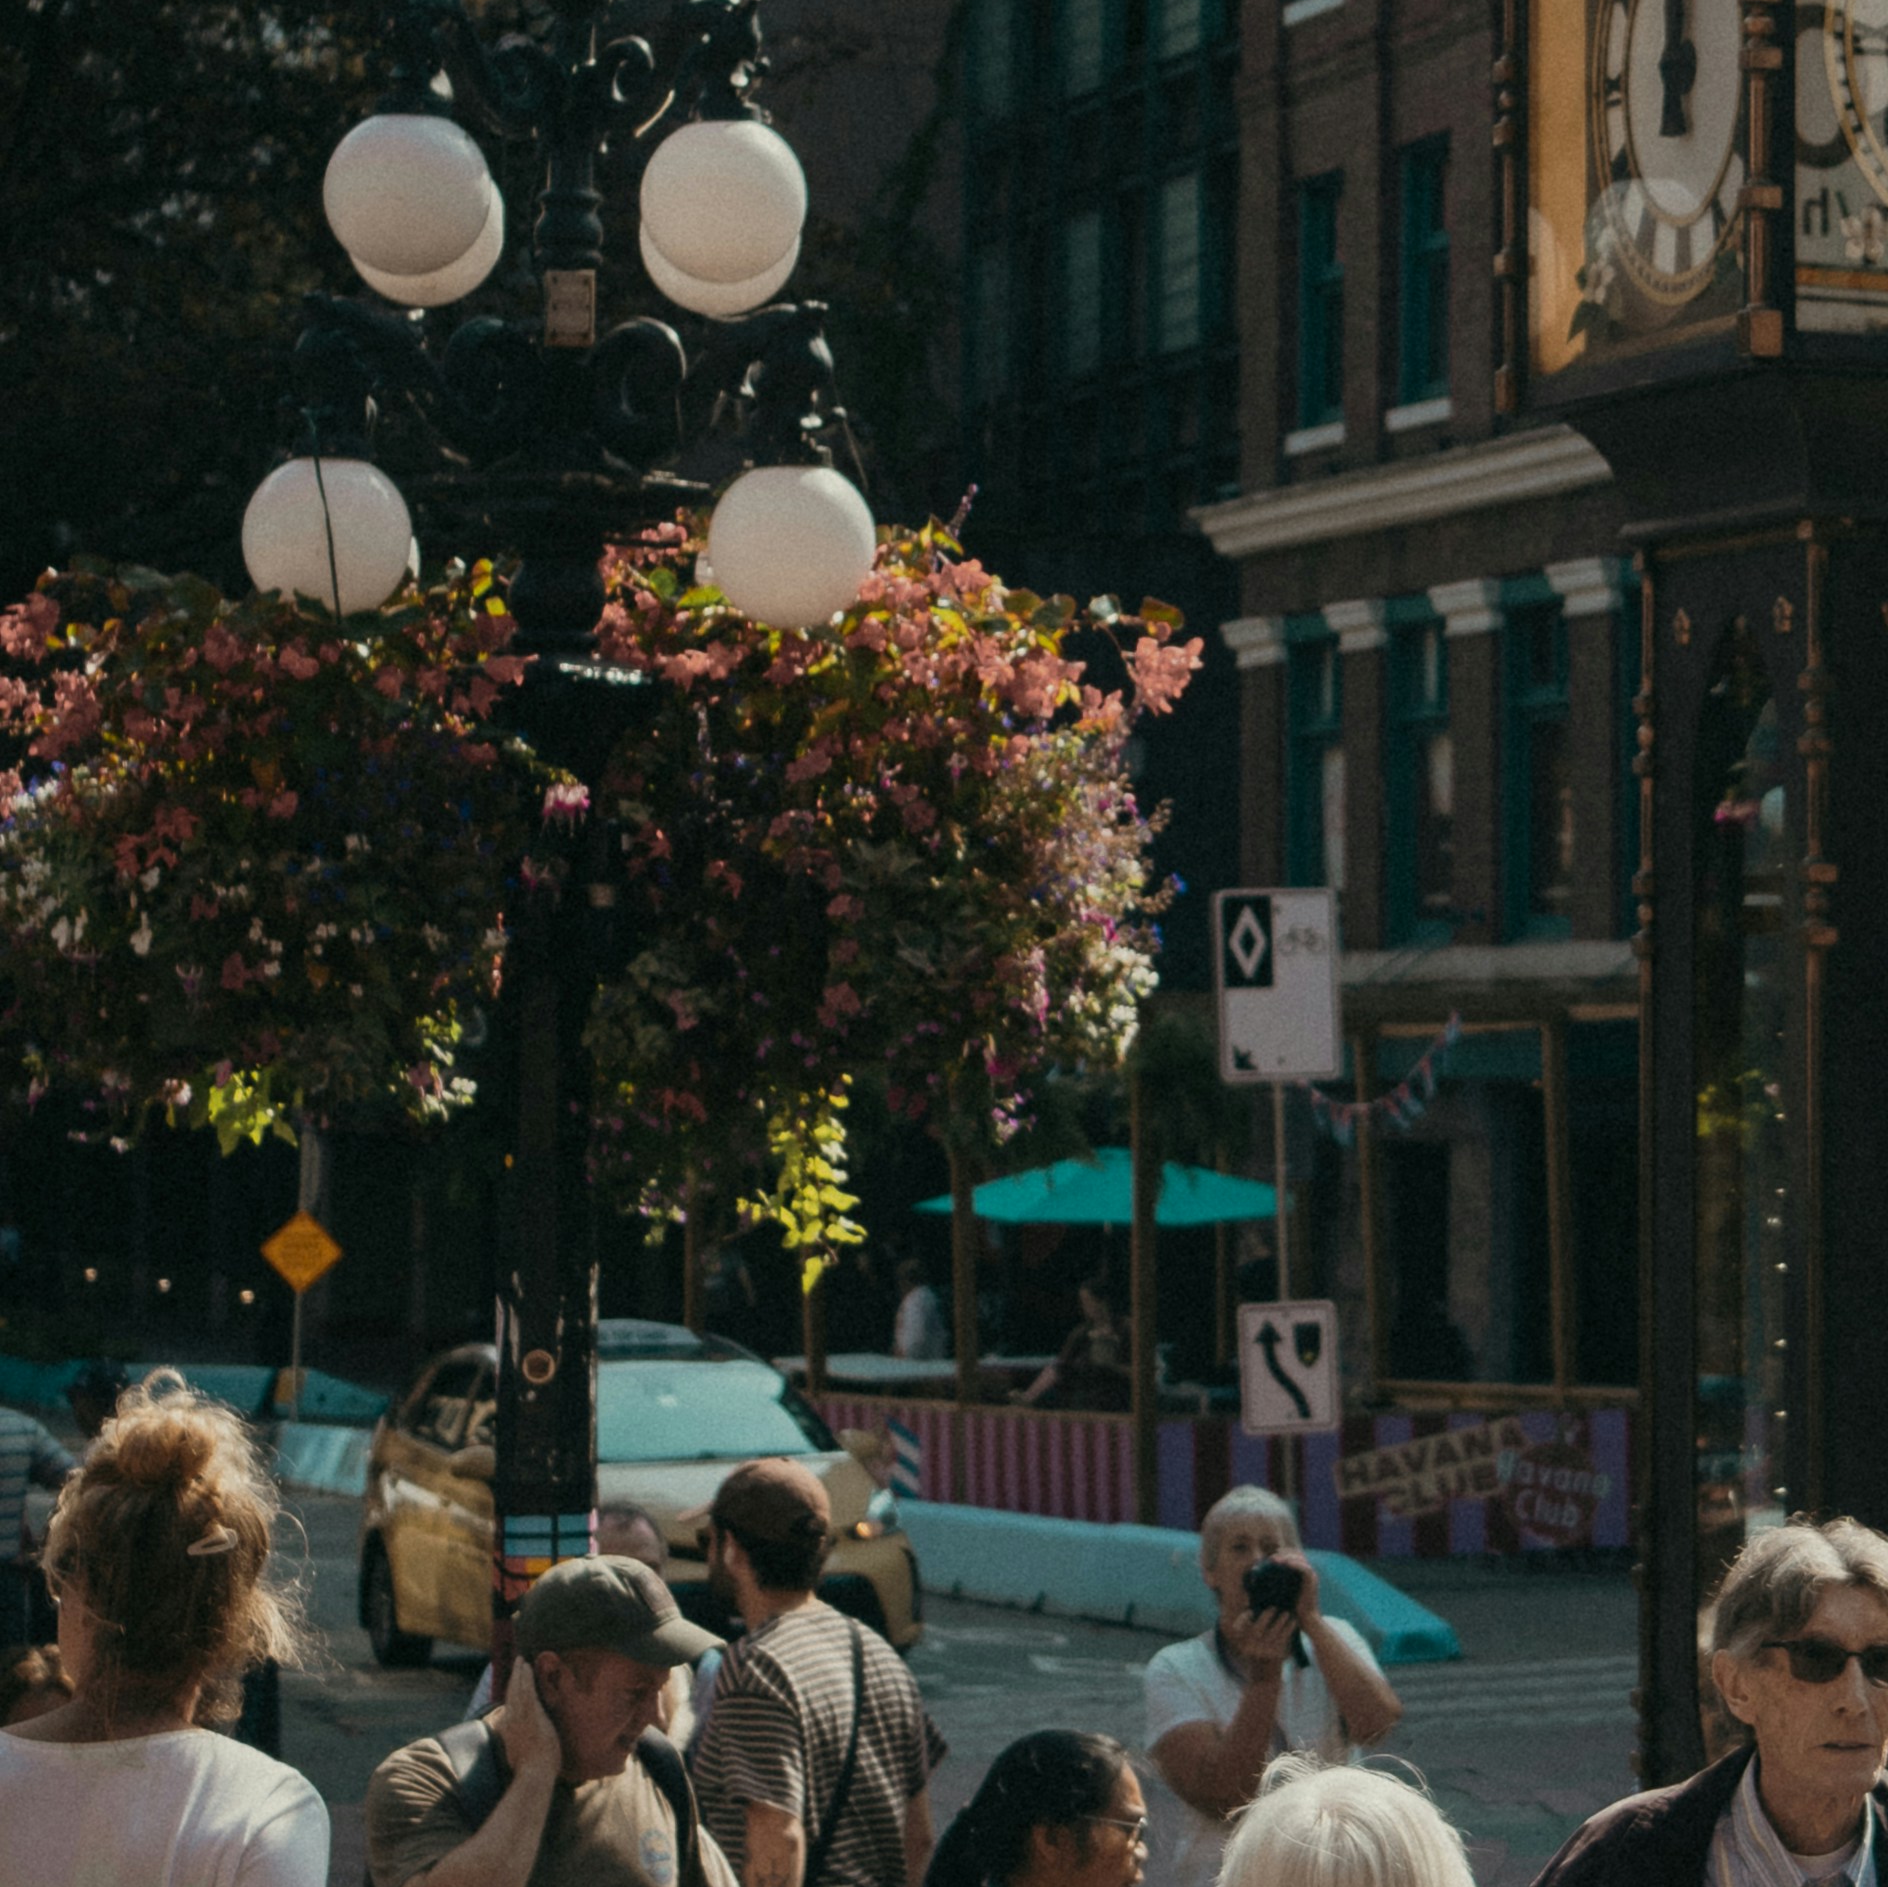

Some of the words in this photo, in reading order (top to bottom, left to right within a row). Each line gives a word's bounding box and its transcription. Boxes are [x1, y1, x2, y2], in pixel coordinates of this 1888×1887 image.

[1342, 1419, 1525, 1489] HAVANA
[1495, 1447, 1613, 1500] Havana
[1514, 1487, 1582, 1529] Club
